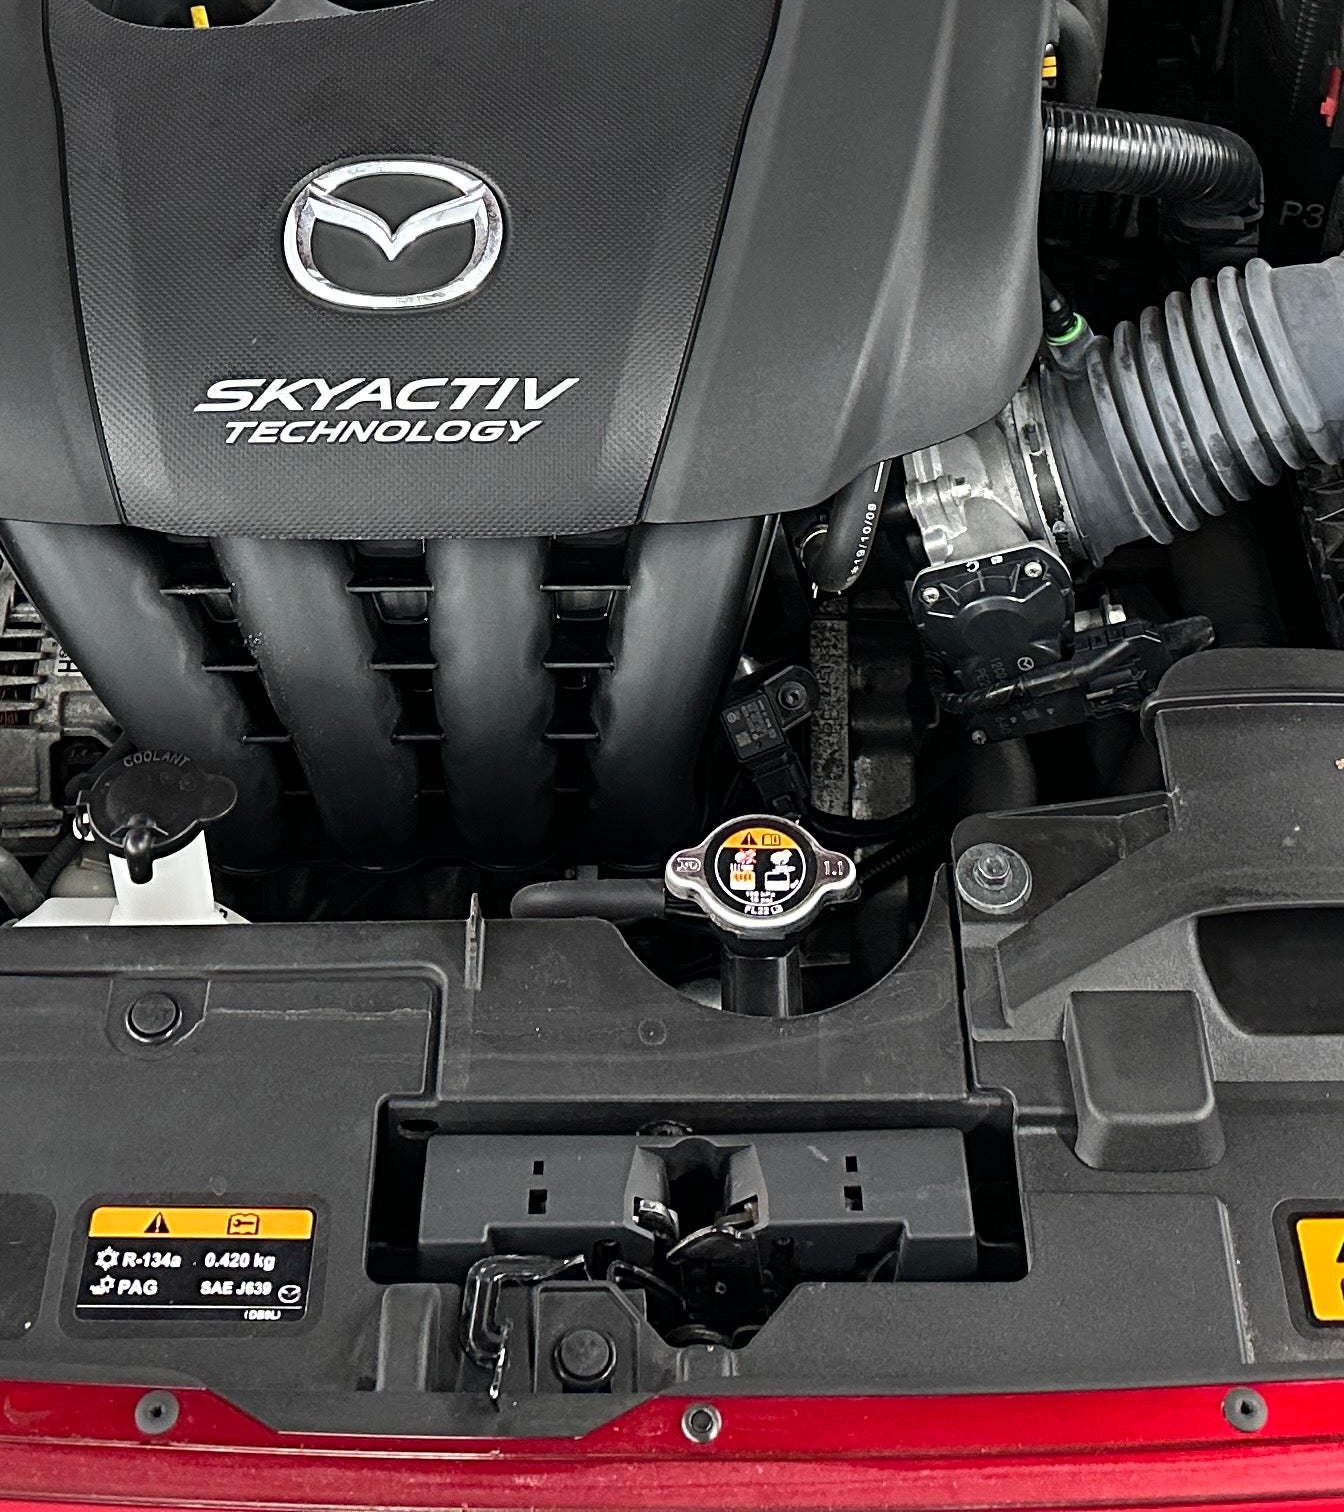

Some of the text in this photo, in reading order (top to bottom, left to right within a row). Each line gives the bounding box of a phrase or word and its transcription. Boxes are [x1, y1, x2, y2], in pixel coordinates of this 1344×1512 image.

[193, 377, 580, 412] SKYACTIV
[224, 420, 543, 444] TECHNOLOGY
[123, 749, 192, 768] COOLANT
[823, 860, 844, 876] 1.1
[122, 1252, 276, 1271] R-134a 0.420 kg
[118, 1279, 273, 1296] PAG SAE J639
